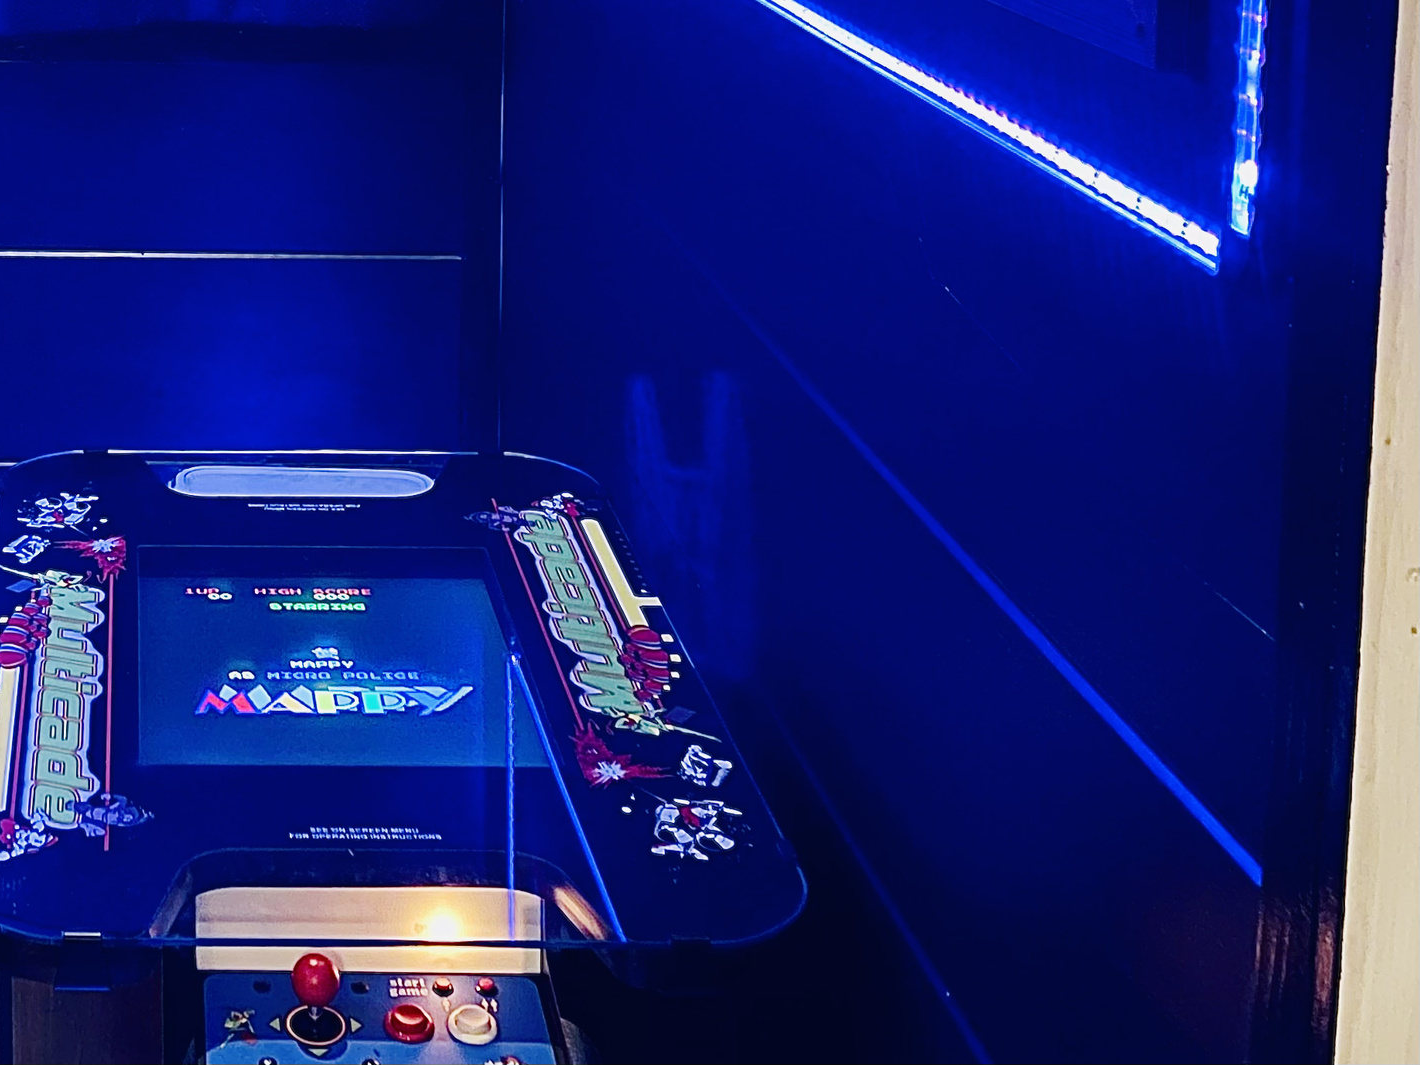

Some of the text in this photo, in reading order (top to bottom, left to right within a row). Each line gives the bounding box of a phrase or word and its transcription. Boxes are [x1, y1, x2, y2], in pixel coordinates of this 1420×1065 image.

[254, 588, 302, 596] HIGH
[268, 602, 366, 611] STARRING
[289, 660, 354, 669] MAPPY
[266, 671, 332, 680] MICRO
[342, 671, 420, 681] POLICE
[194, 683, 474, 717] MAPPY
